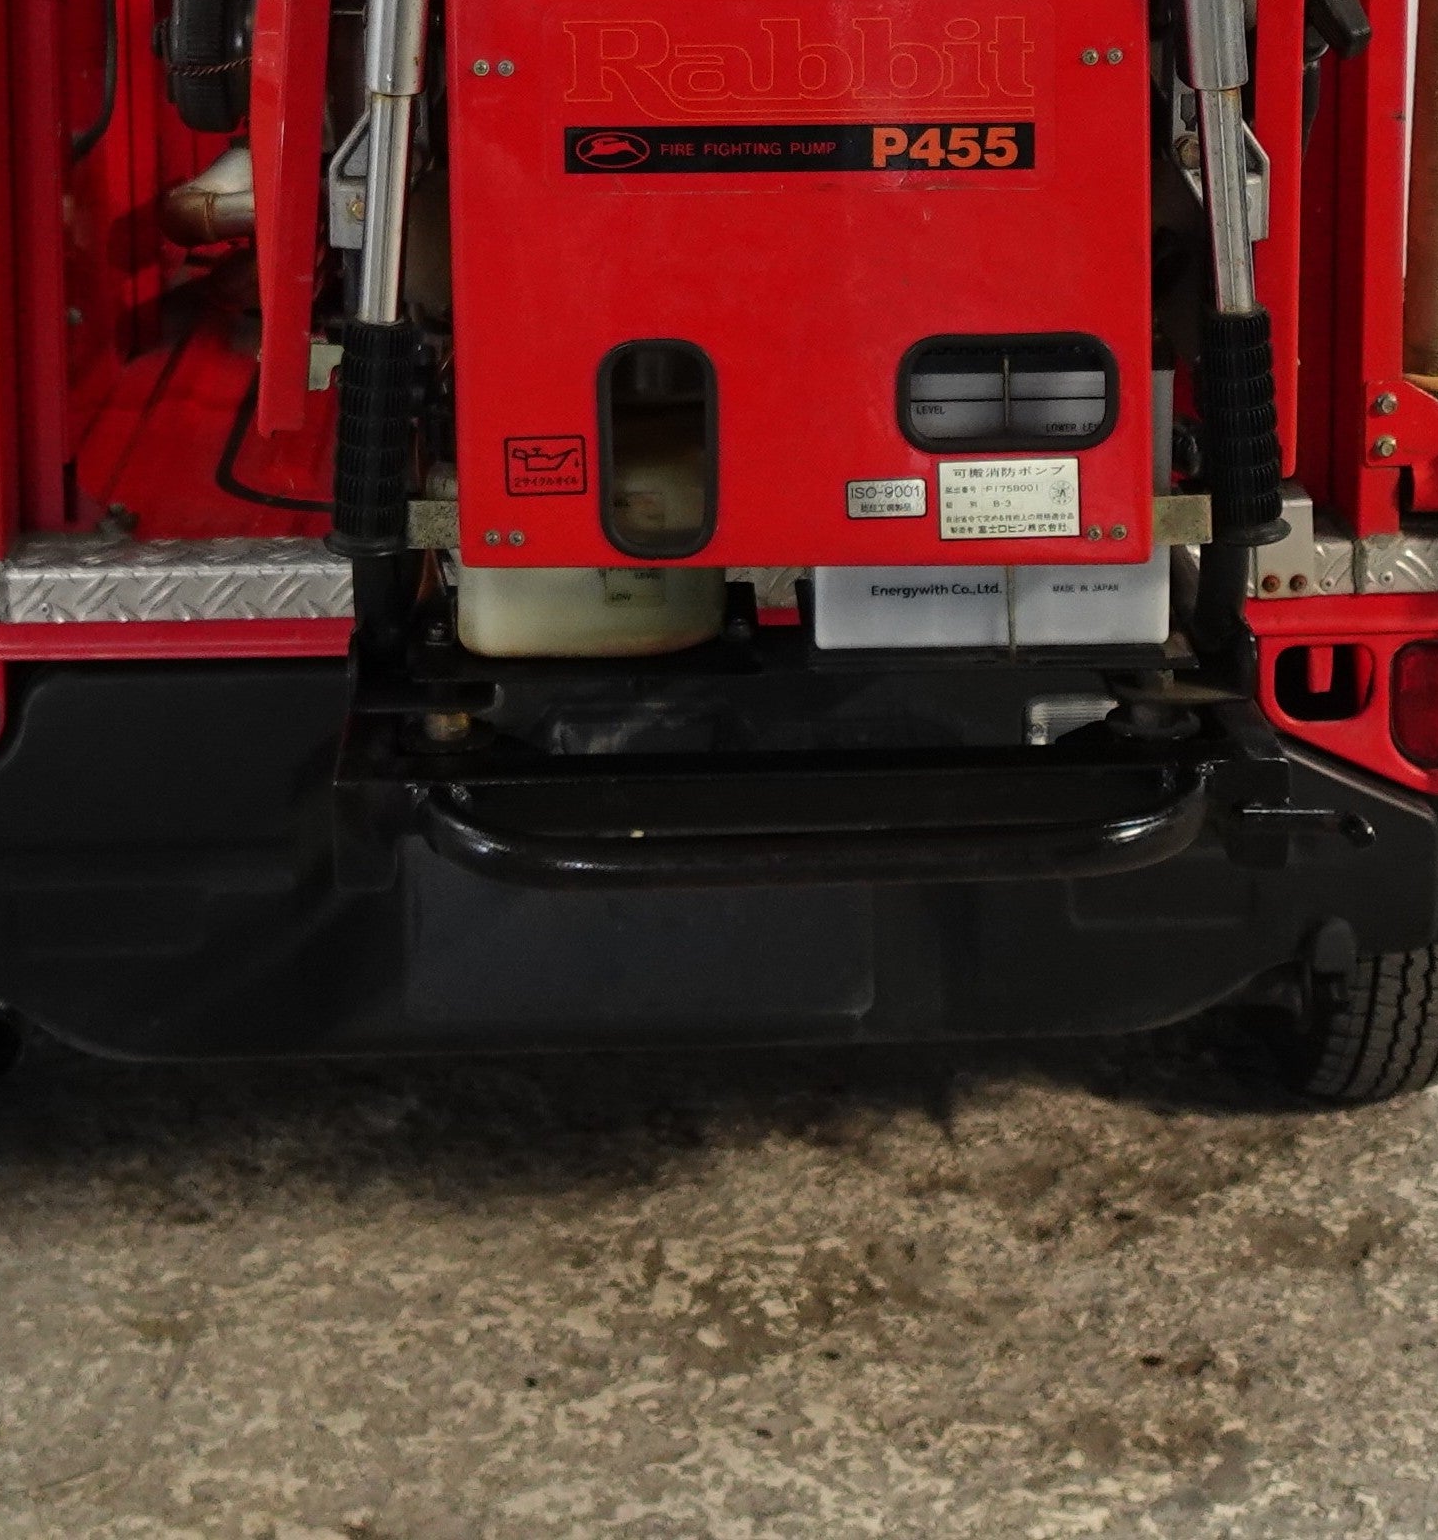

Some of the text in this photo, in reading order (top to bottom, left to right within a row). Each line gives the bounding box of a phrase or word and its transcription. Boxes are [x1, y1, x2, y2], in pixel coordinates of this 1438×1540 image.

[563, 16, 1035, 121] Rabbit
[660, 141, 837, 157] FIRE FIGHTING PUMP
[872, 127, 1019, 167] P455
[916, 405, 946, 415] LEVEL
[1046, 423, 1077, 432] LOWER
[871, 584, 949, 599] Energywith
[1052, 584, 1075, 593] MADE
[1091, 583, 1119, 592] JAPAN
